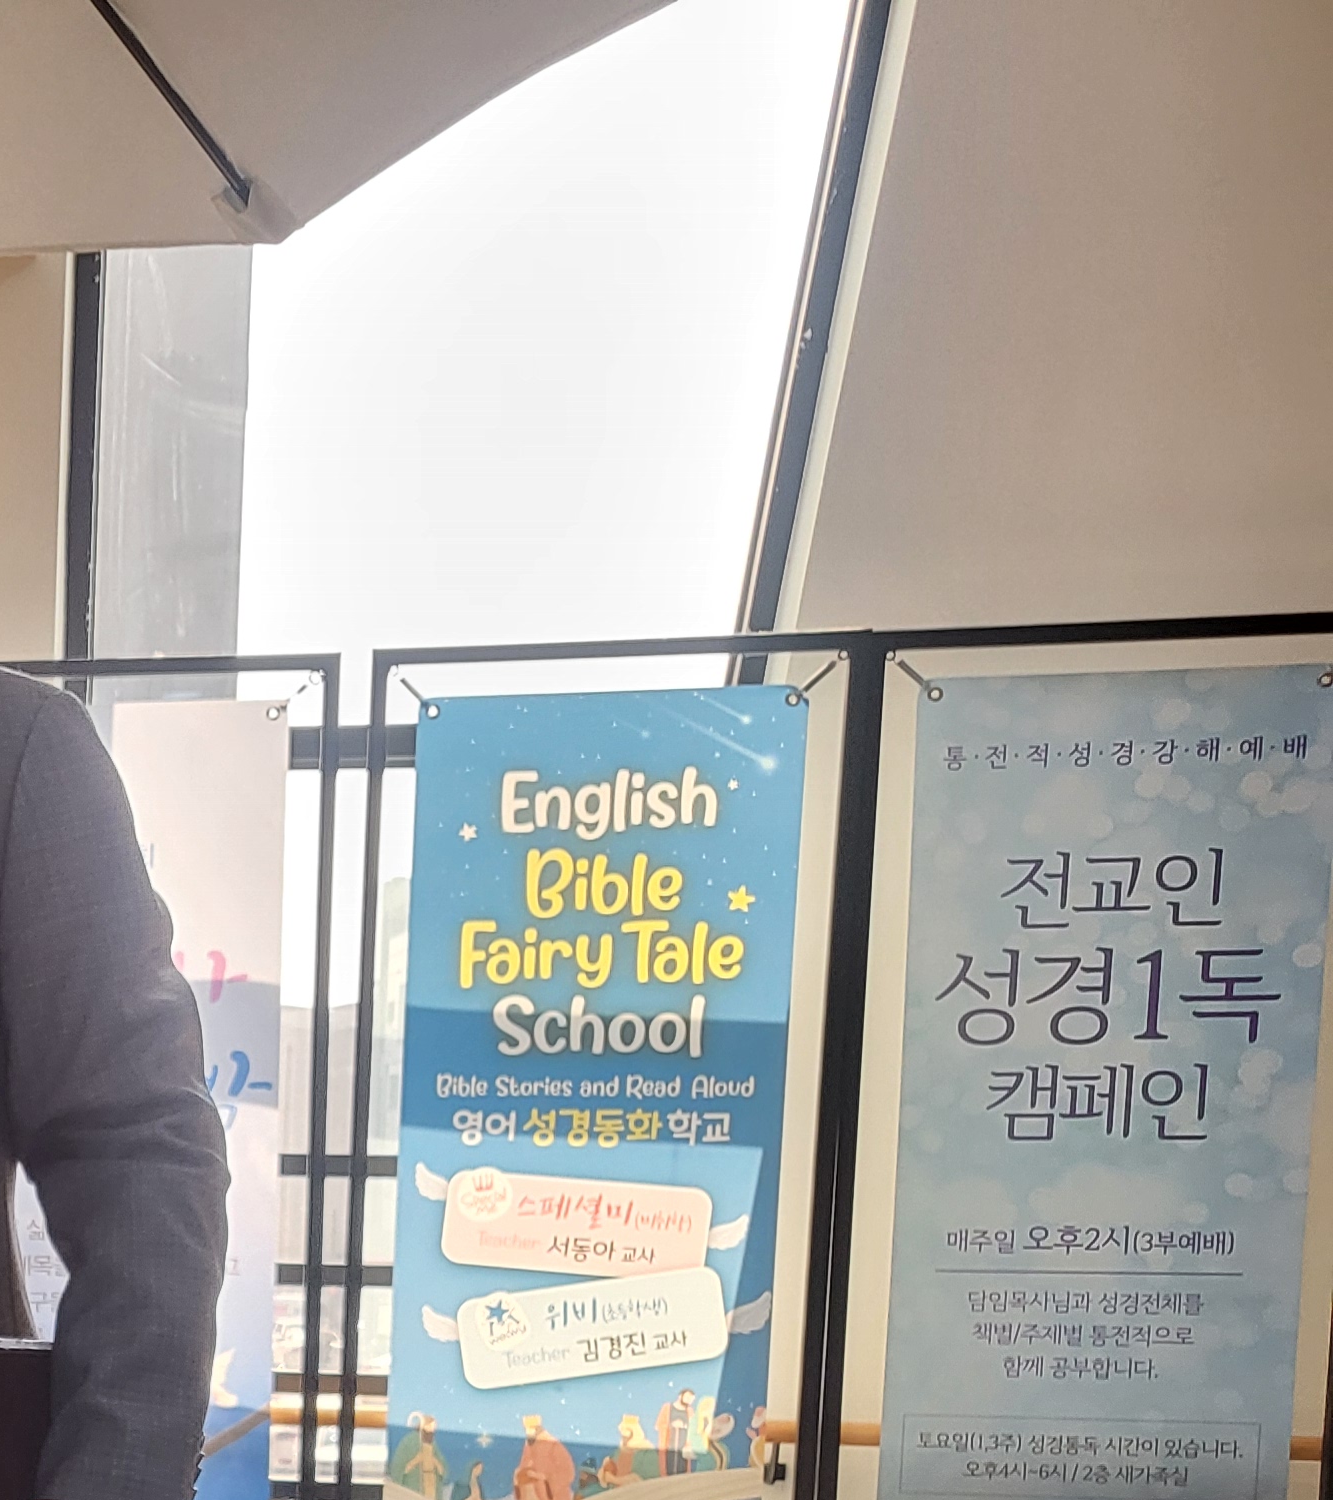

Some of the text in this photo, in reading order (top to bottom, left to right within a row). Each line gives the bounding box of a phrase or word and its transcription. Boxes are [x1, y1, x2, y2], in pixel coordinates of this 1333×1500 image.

[500, 766, 718, 841] English
[526, 848, 683, 919] Bible
[1000, 847, 1224, 930] 전교인
[459, 919, 745, 989] Fairy Tale
[935, 945, 1282, 1046] 성경1독
[492, 994, 707, 1059] School
[436, 1073, 755, 1099] Bible Stories and Read Aloud
[985, 1062, 1209, 1142] 캠페인
[452, 1108, 732, 1149] 영어 성경동화 학교
[547, 1235, 616, 1263] 서동아
[621, 1247, 656, 1264] 교사
[946, 1224, 1235, 1257] 매주일 오후2시(3부예배)
[967, 1290, 1205, 1316] 담임목사님과 성경전체를
[502, 1329, 689, 1369] Teacher 김경진 교사
[1089, 1324, 1195, 1348] 통전적으로
[1003, 1355, 1160, 1380] 함께 공부합니다.
[1105, 1436, 1160, 1457] 시간이
[1164, 1437, 1243, 1459] 있습니다.
